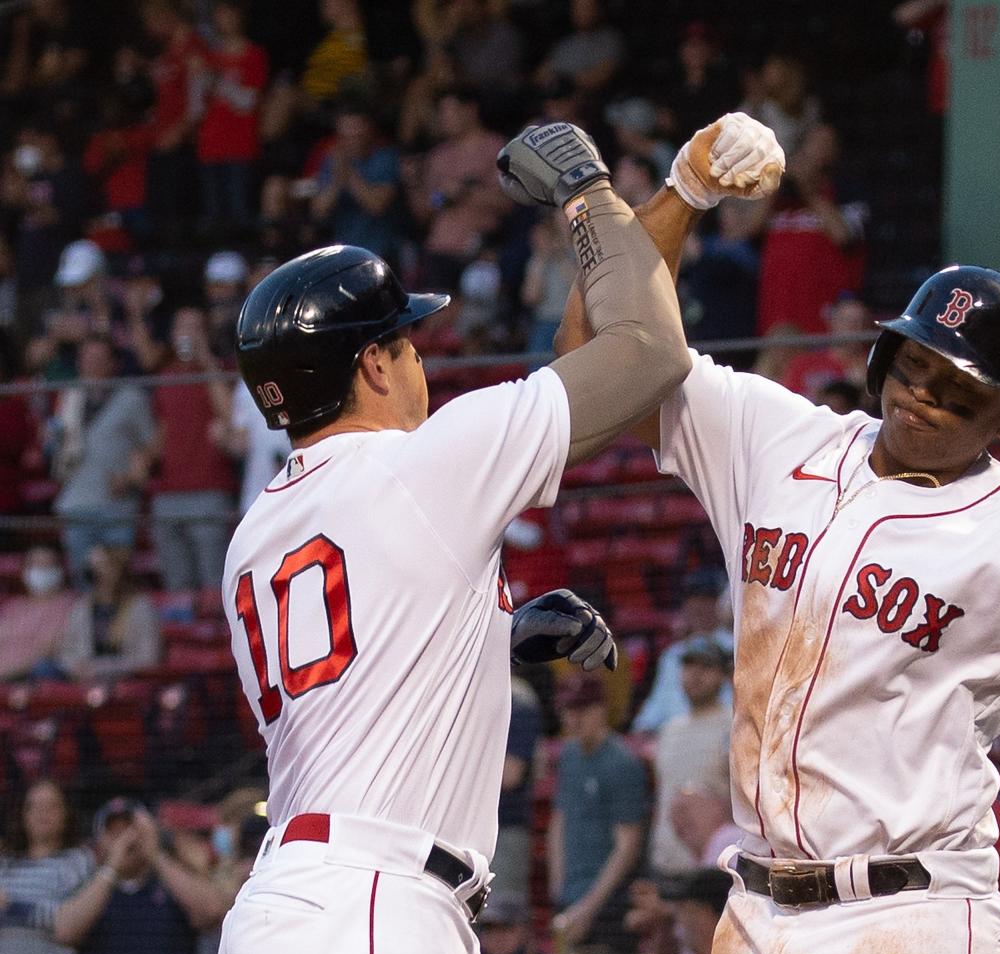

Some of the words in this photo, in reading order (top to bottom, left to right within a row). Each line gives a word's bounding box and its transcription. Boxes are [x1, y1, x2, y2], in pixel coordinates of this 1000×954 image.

[572, 217, 598, 277] FREE
[936, 288, 975, 328] B
[257, 382, 284, 408] 10
[235, 533, 358, 726] 10
[842, 563, 965, 653] SOX
